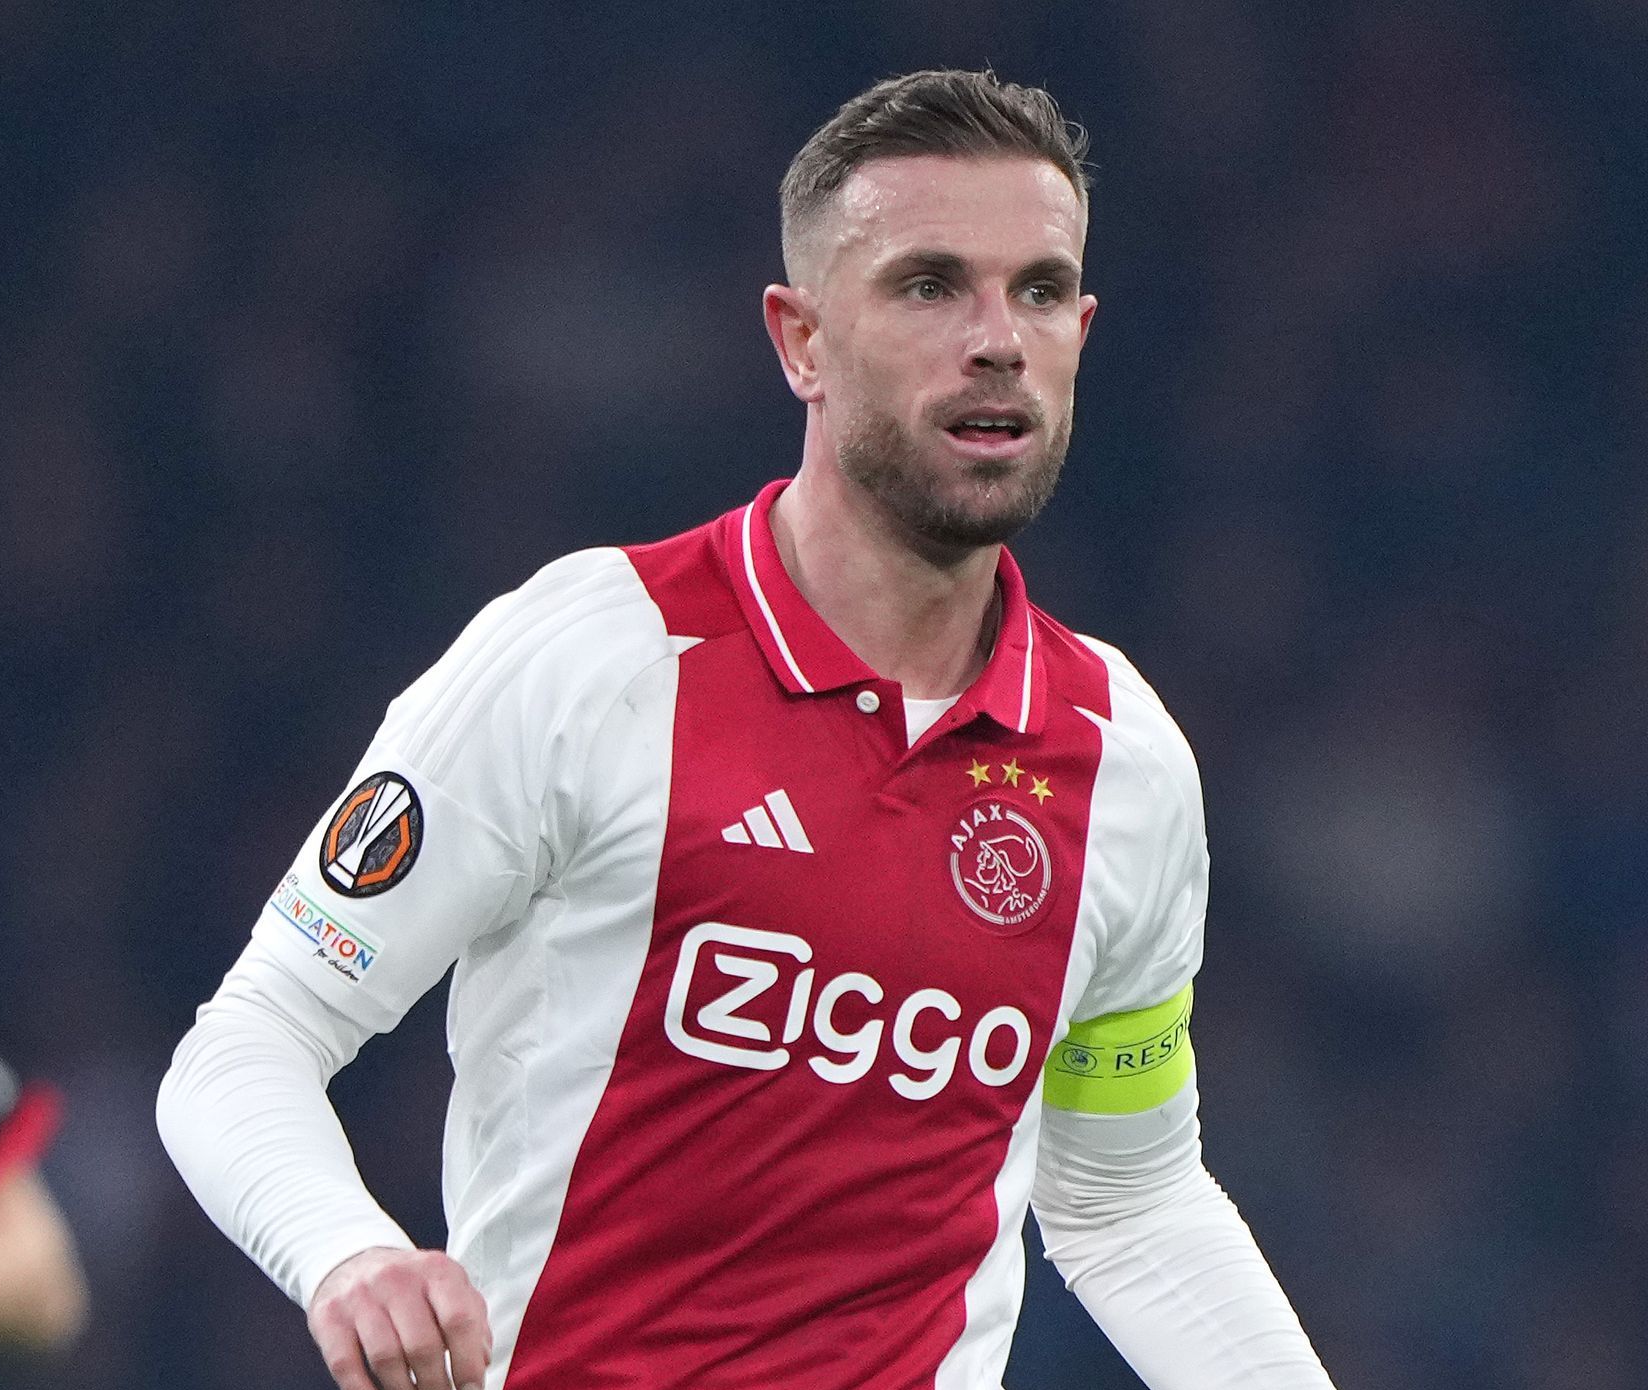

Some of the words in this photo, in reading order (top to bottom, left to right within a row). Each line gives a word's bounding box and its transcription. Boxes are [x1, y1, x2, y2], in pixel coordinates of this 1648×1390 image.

[951, 804, 1003, 851] AJAX
[1005, 889, 1048, 924] AMSTERDAM
[664, 922, 1032, 1100] Ziggo
